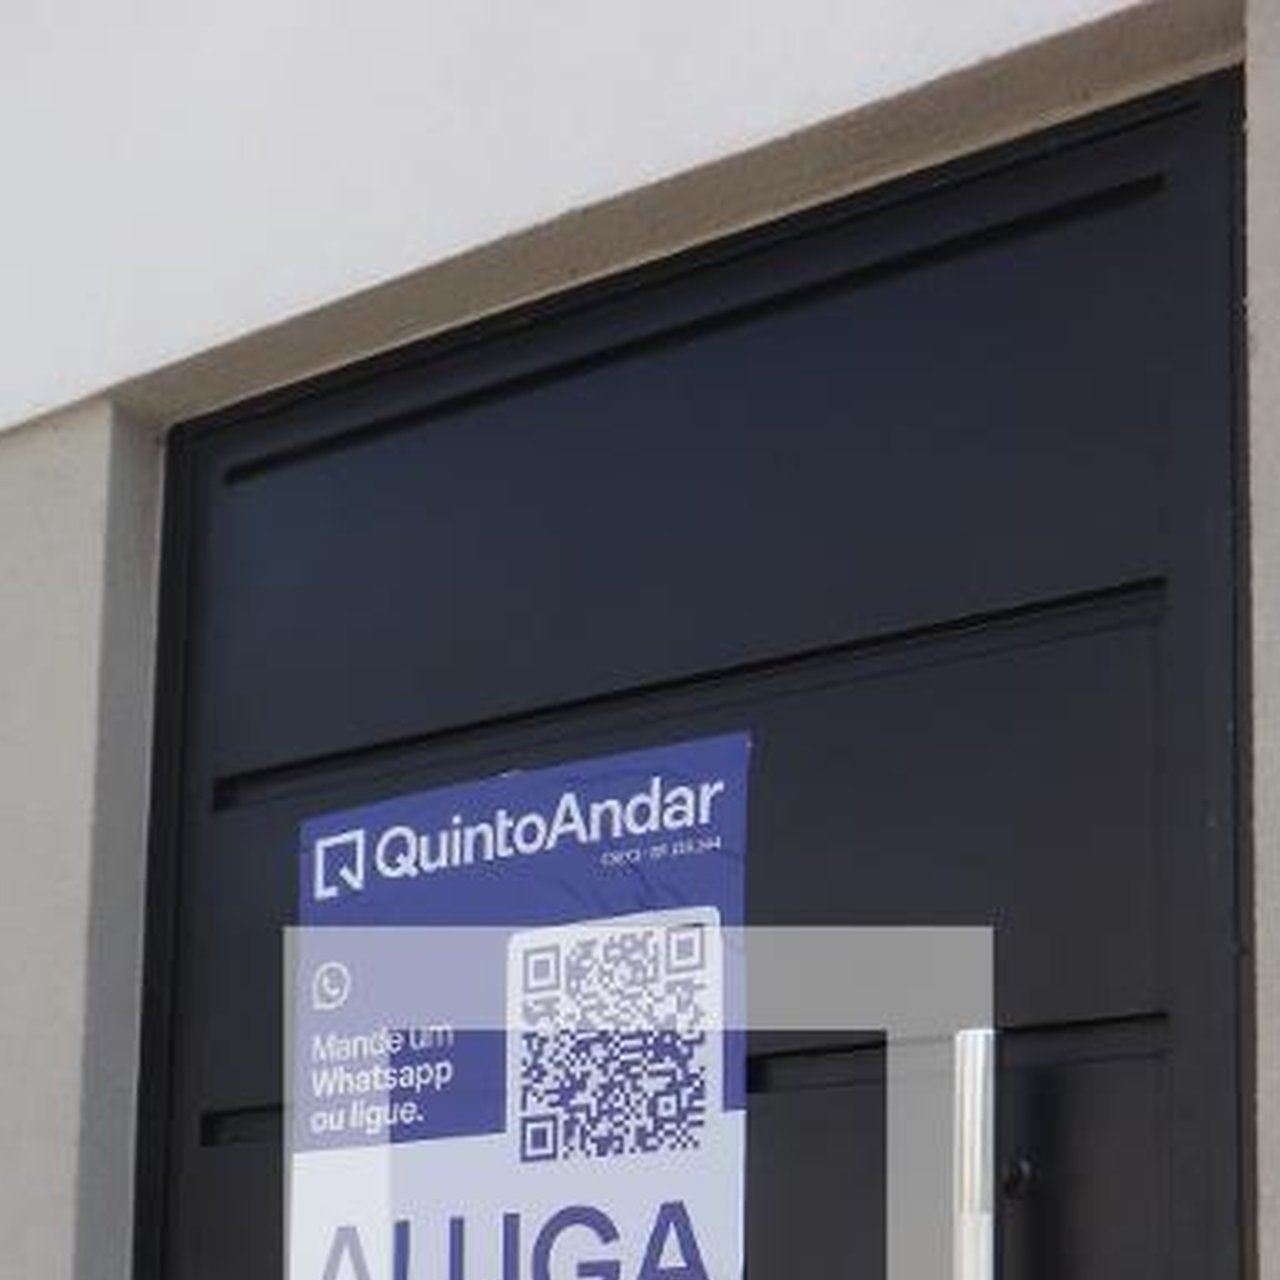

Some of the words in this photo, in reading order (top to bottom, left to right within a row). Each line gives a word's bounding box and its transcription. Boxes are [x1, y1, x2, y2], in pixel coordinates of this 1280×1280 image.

[375, 776, 725, 879] QuintoAndar
[312, 1026, 406, 1062] Mande
[409, 1024, 454, 1050] um
[312, 1059, 453, 1098] Whatsapp
[310, 1109, 345, 1134] ou
[350, 1098, 425, 1135] ligue.
